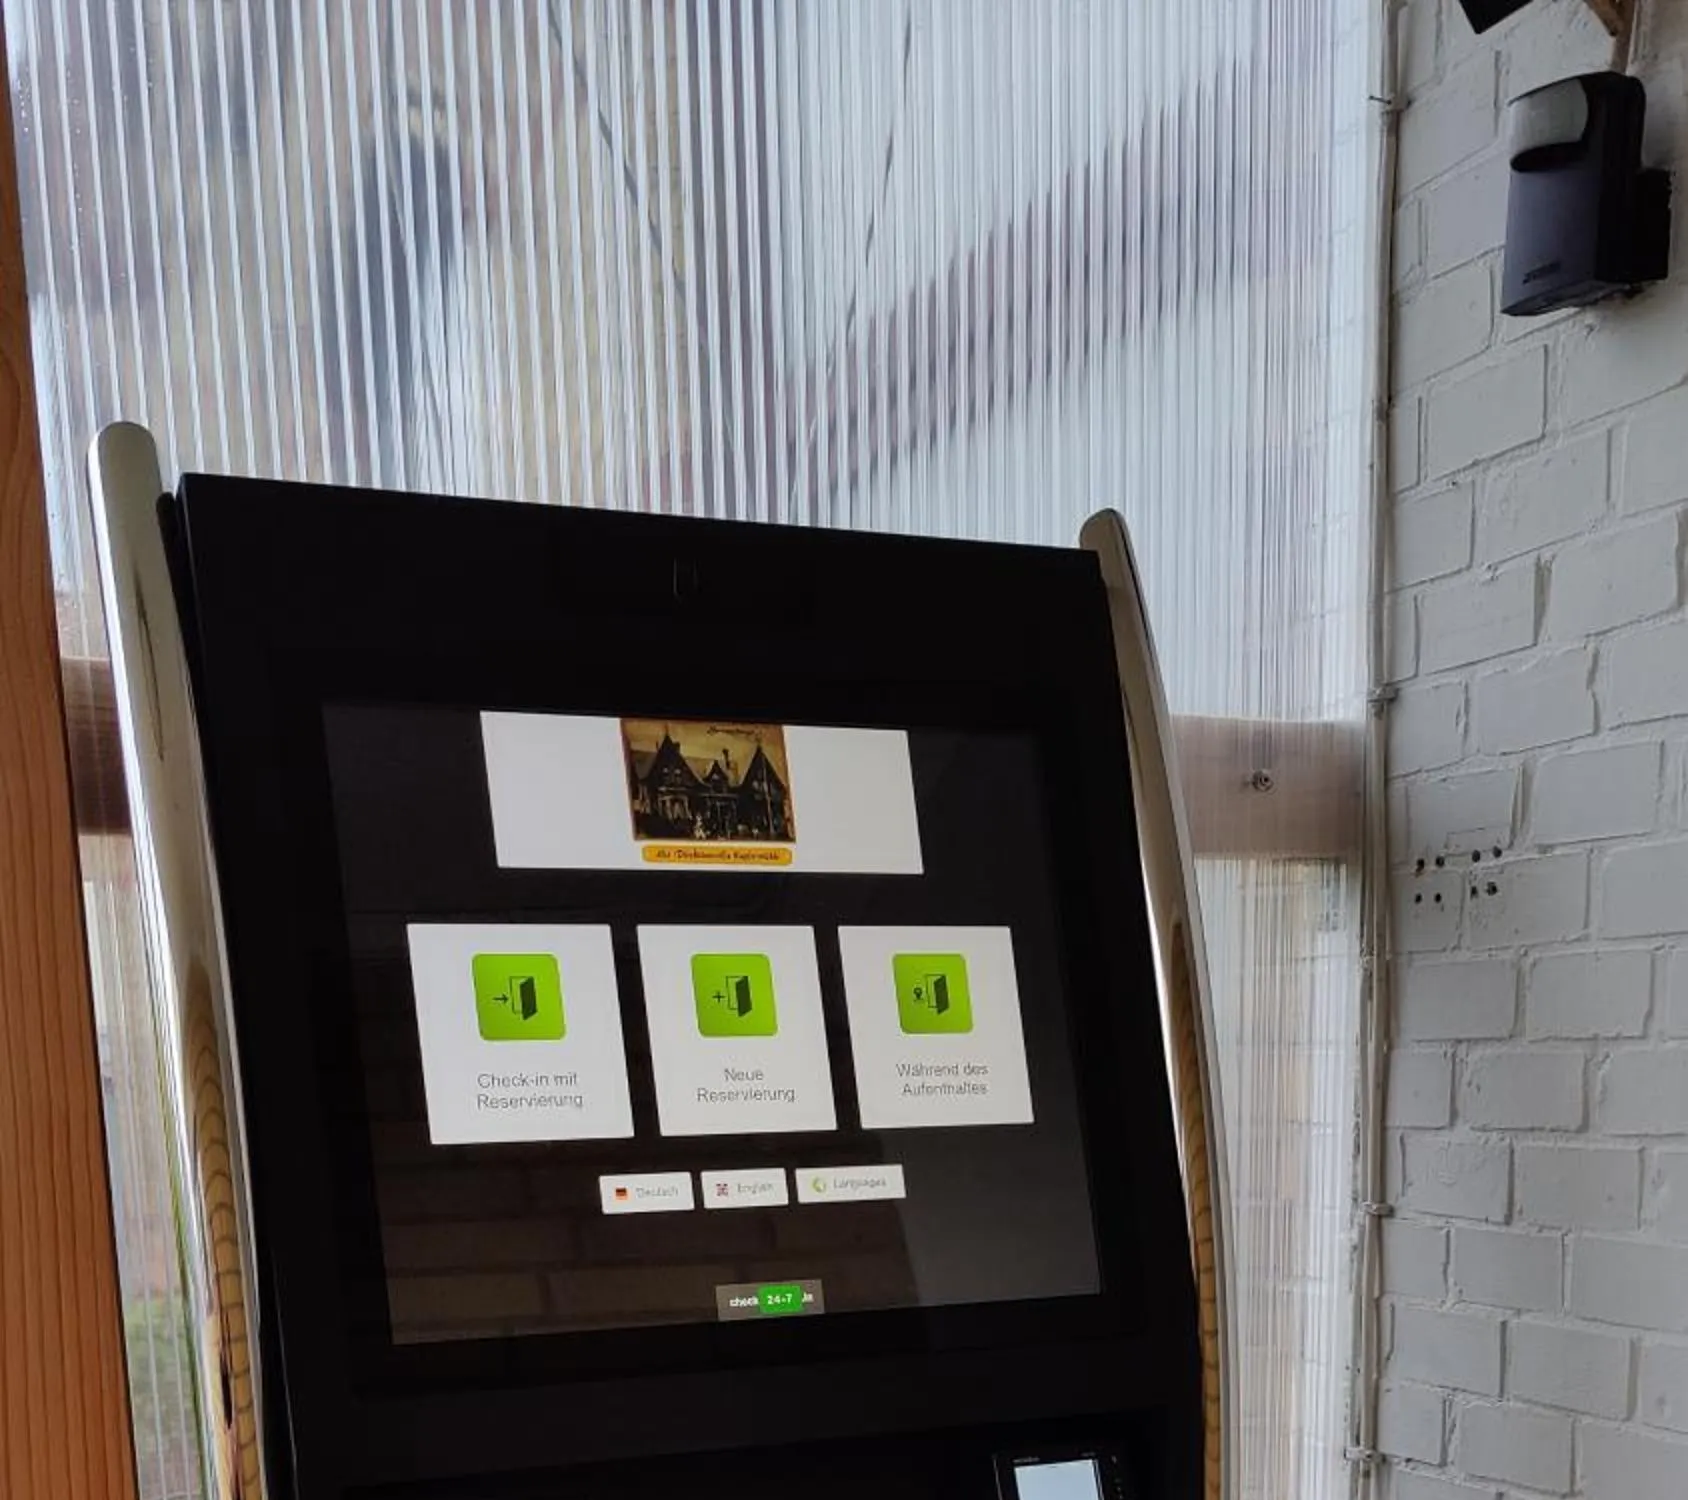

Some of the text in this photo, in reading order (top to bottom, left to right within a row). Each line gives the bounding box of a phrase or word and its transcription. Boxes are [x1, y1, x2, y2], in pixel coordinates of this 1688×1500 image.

[724, 1067, 764, 1081] Neue
[895, 1061, 989, 1077] Während des
[477, 1072, 577, 1089] Check-in mit
[477, 1092, 583, 1110] Reservierung
[696, 1087, 796, 1103] Reservierung
